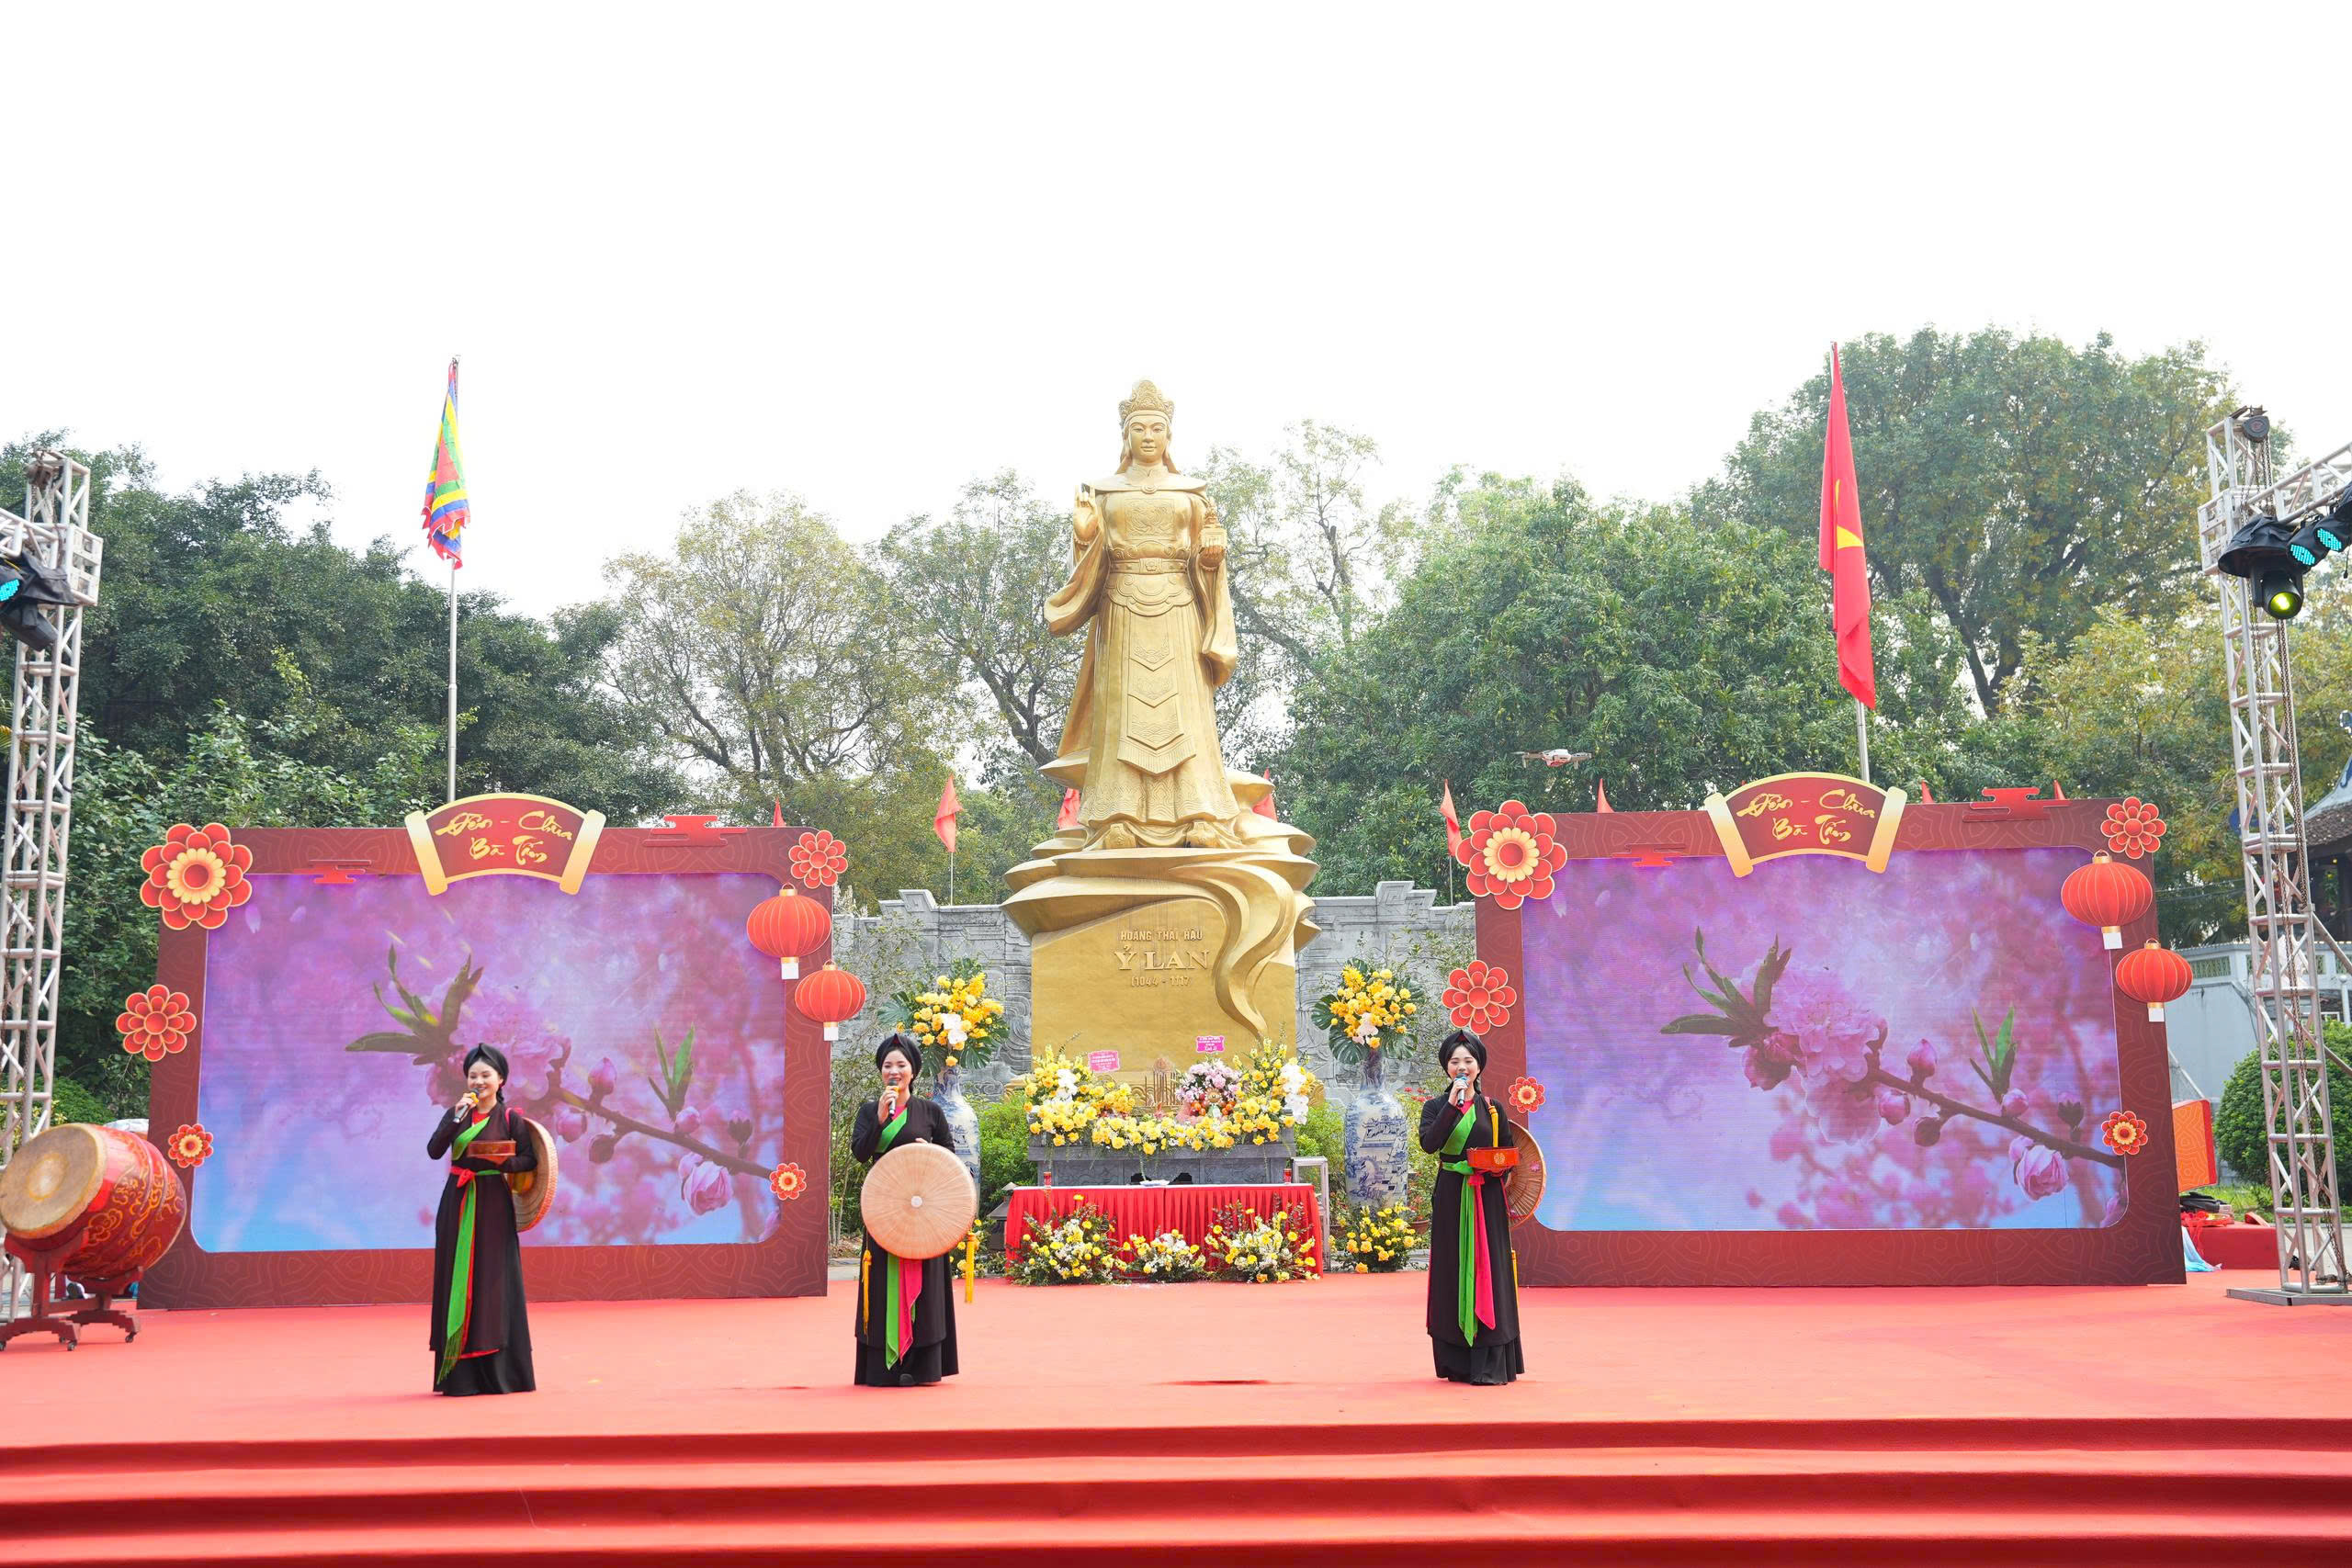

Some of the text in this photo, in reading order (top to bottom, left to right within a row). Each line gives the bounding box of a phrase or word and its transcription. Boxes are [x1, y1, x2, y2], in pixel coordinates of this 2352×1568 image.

[1771, 818, 1808, 840] Bà
[469, 837, 505, 861] Bà
[1144, 949, 1210, 971] LAN
